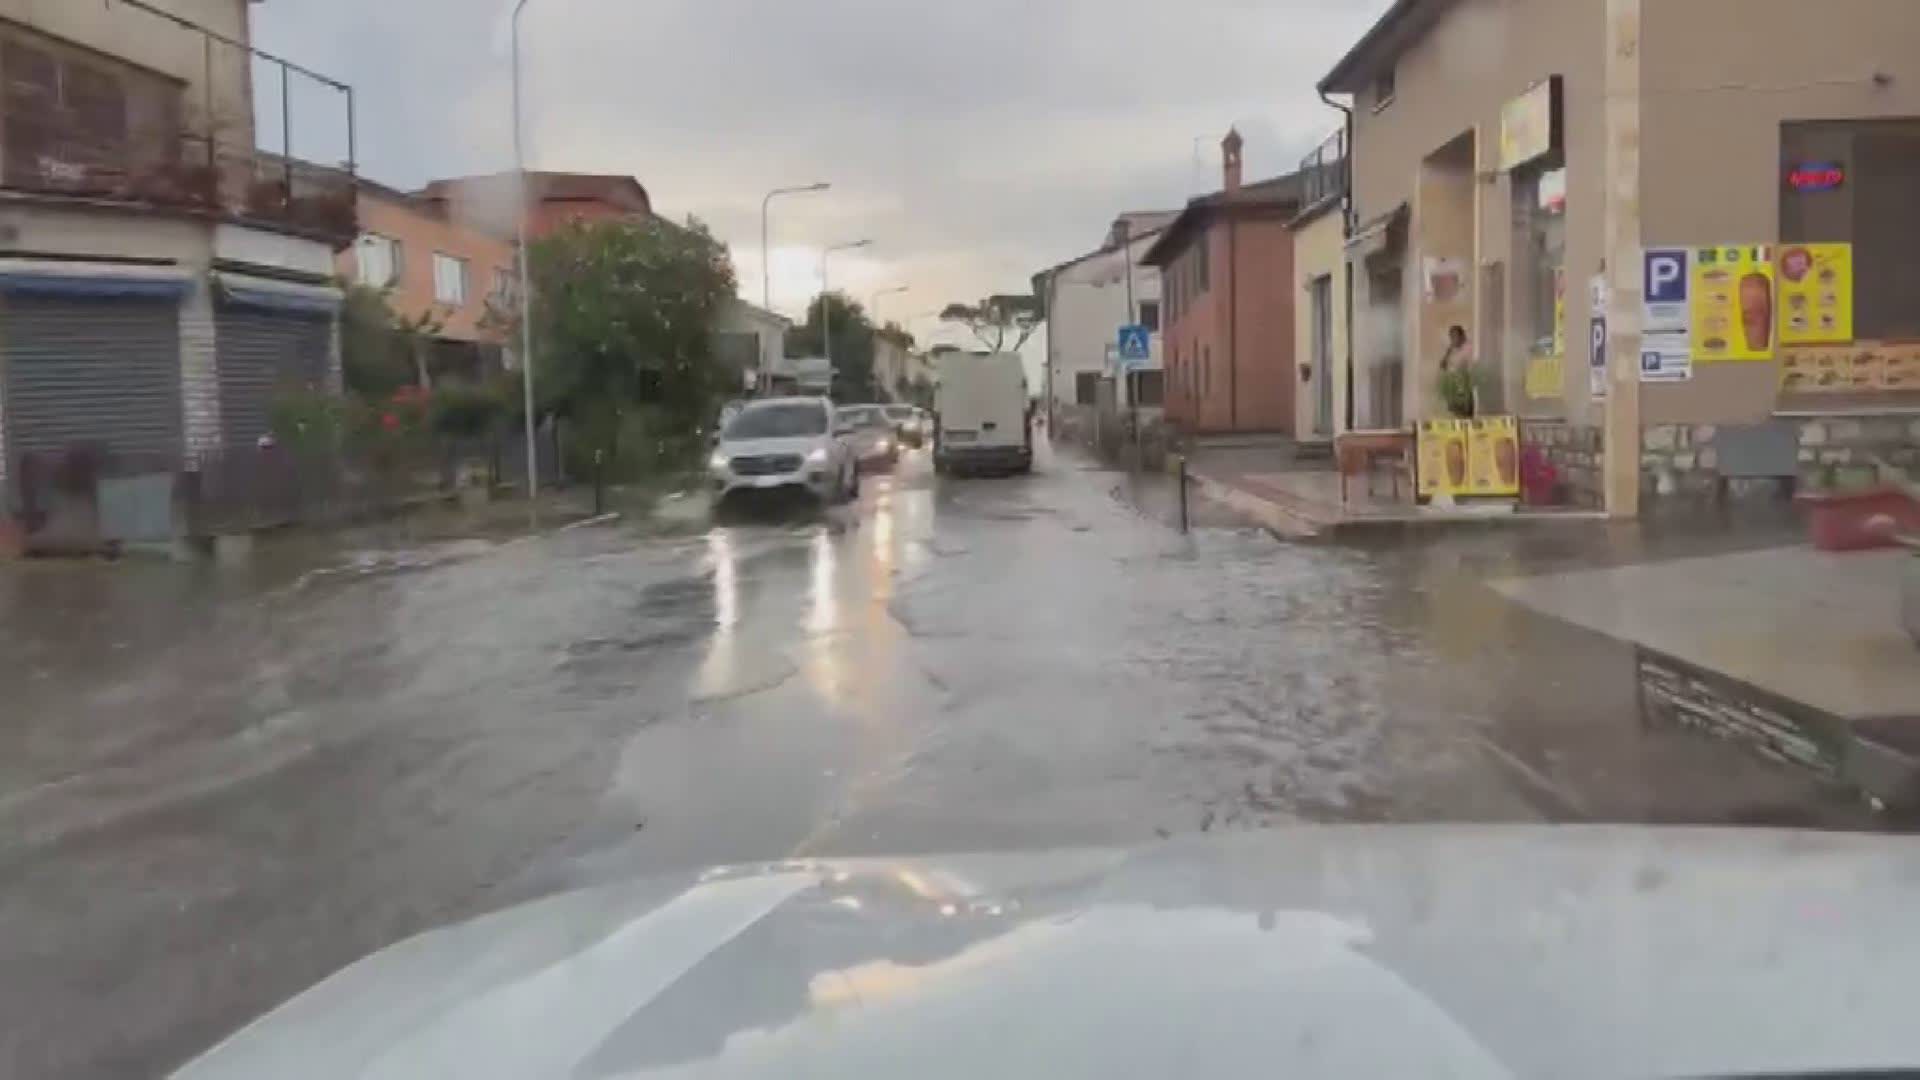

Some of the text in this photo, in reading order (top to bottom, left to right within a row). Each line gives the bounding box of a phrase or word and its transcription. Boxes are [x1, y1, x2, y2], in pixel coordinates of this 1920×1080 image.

[1649, 256, 1680, 296] P
[1593, 324, 1604, 362] P
[1645, 354, 1658, 370] P
